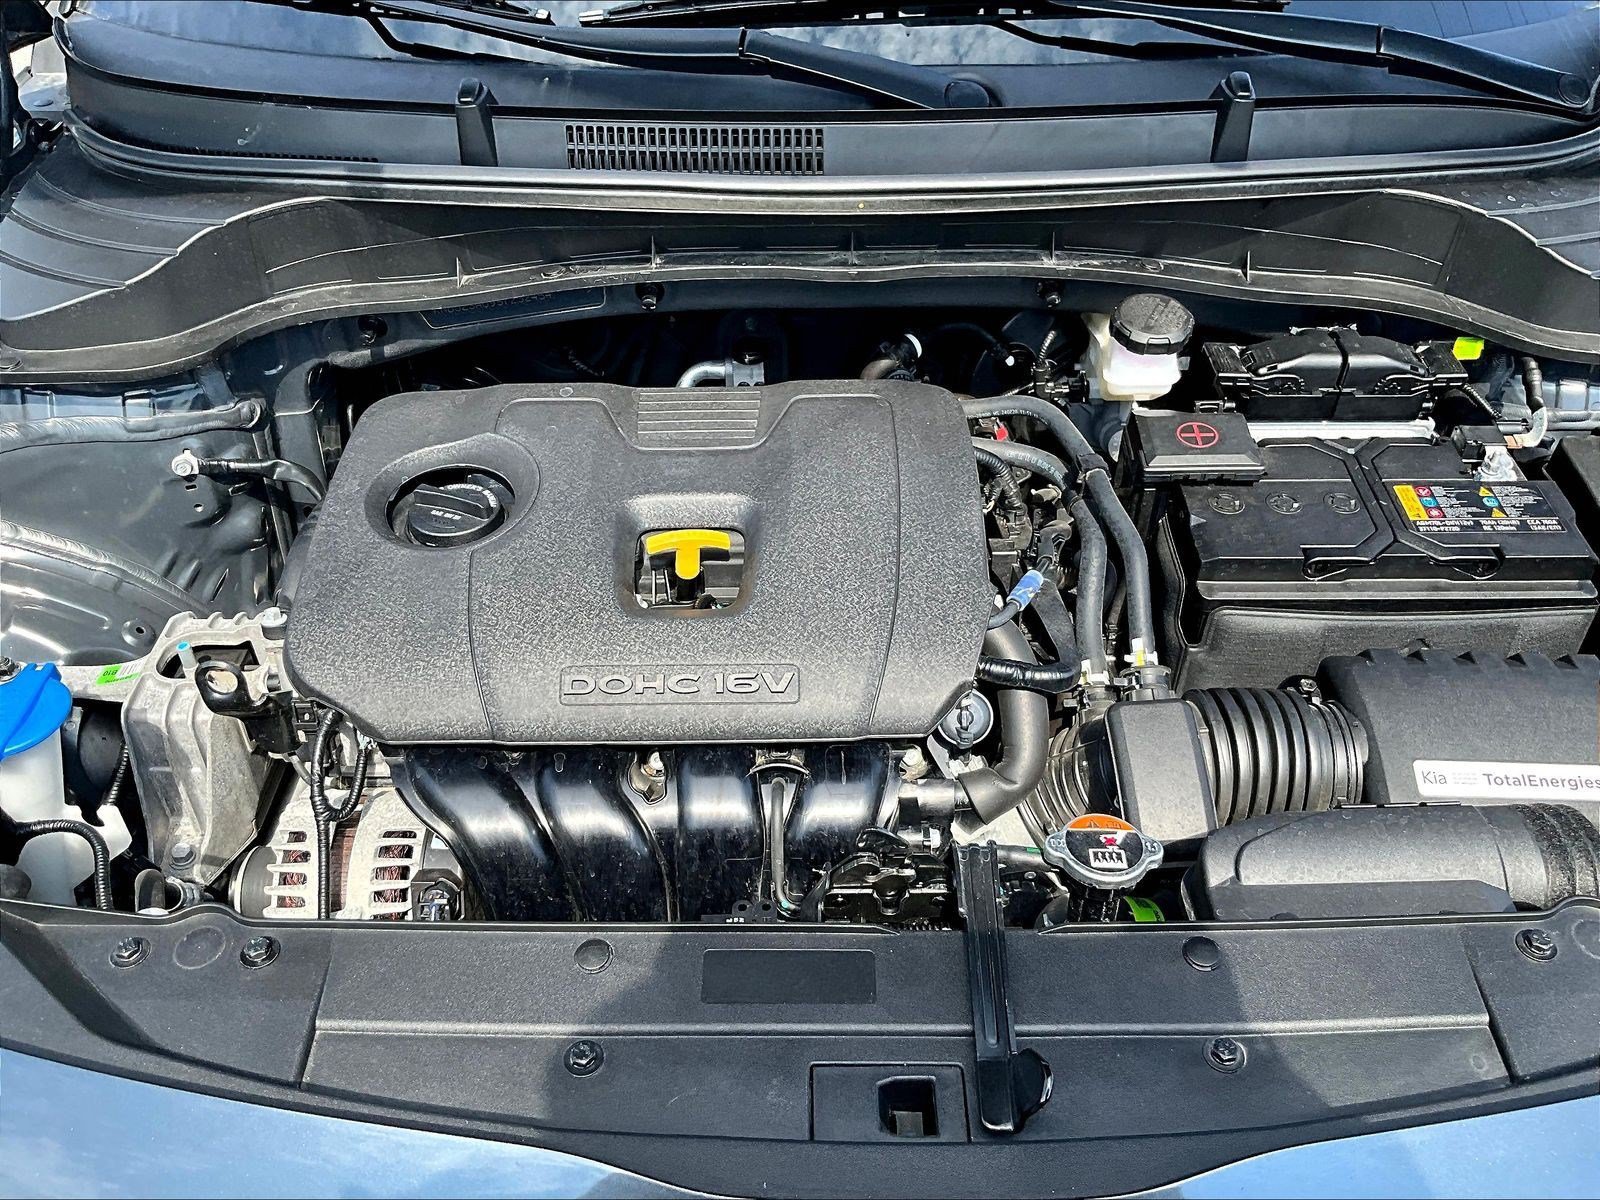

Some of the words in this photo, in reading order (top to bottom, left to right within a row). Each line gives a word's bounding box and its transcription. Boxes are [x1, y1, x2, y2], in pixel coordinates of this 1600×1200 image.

[563, 673, 702, 696] DOHC
[714, 672, 796, 695] 16V
[1421, 770, 1448, 785] Kia
[1482, 772, 1600, 791] TotalEnergies
